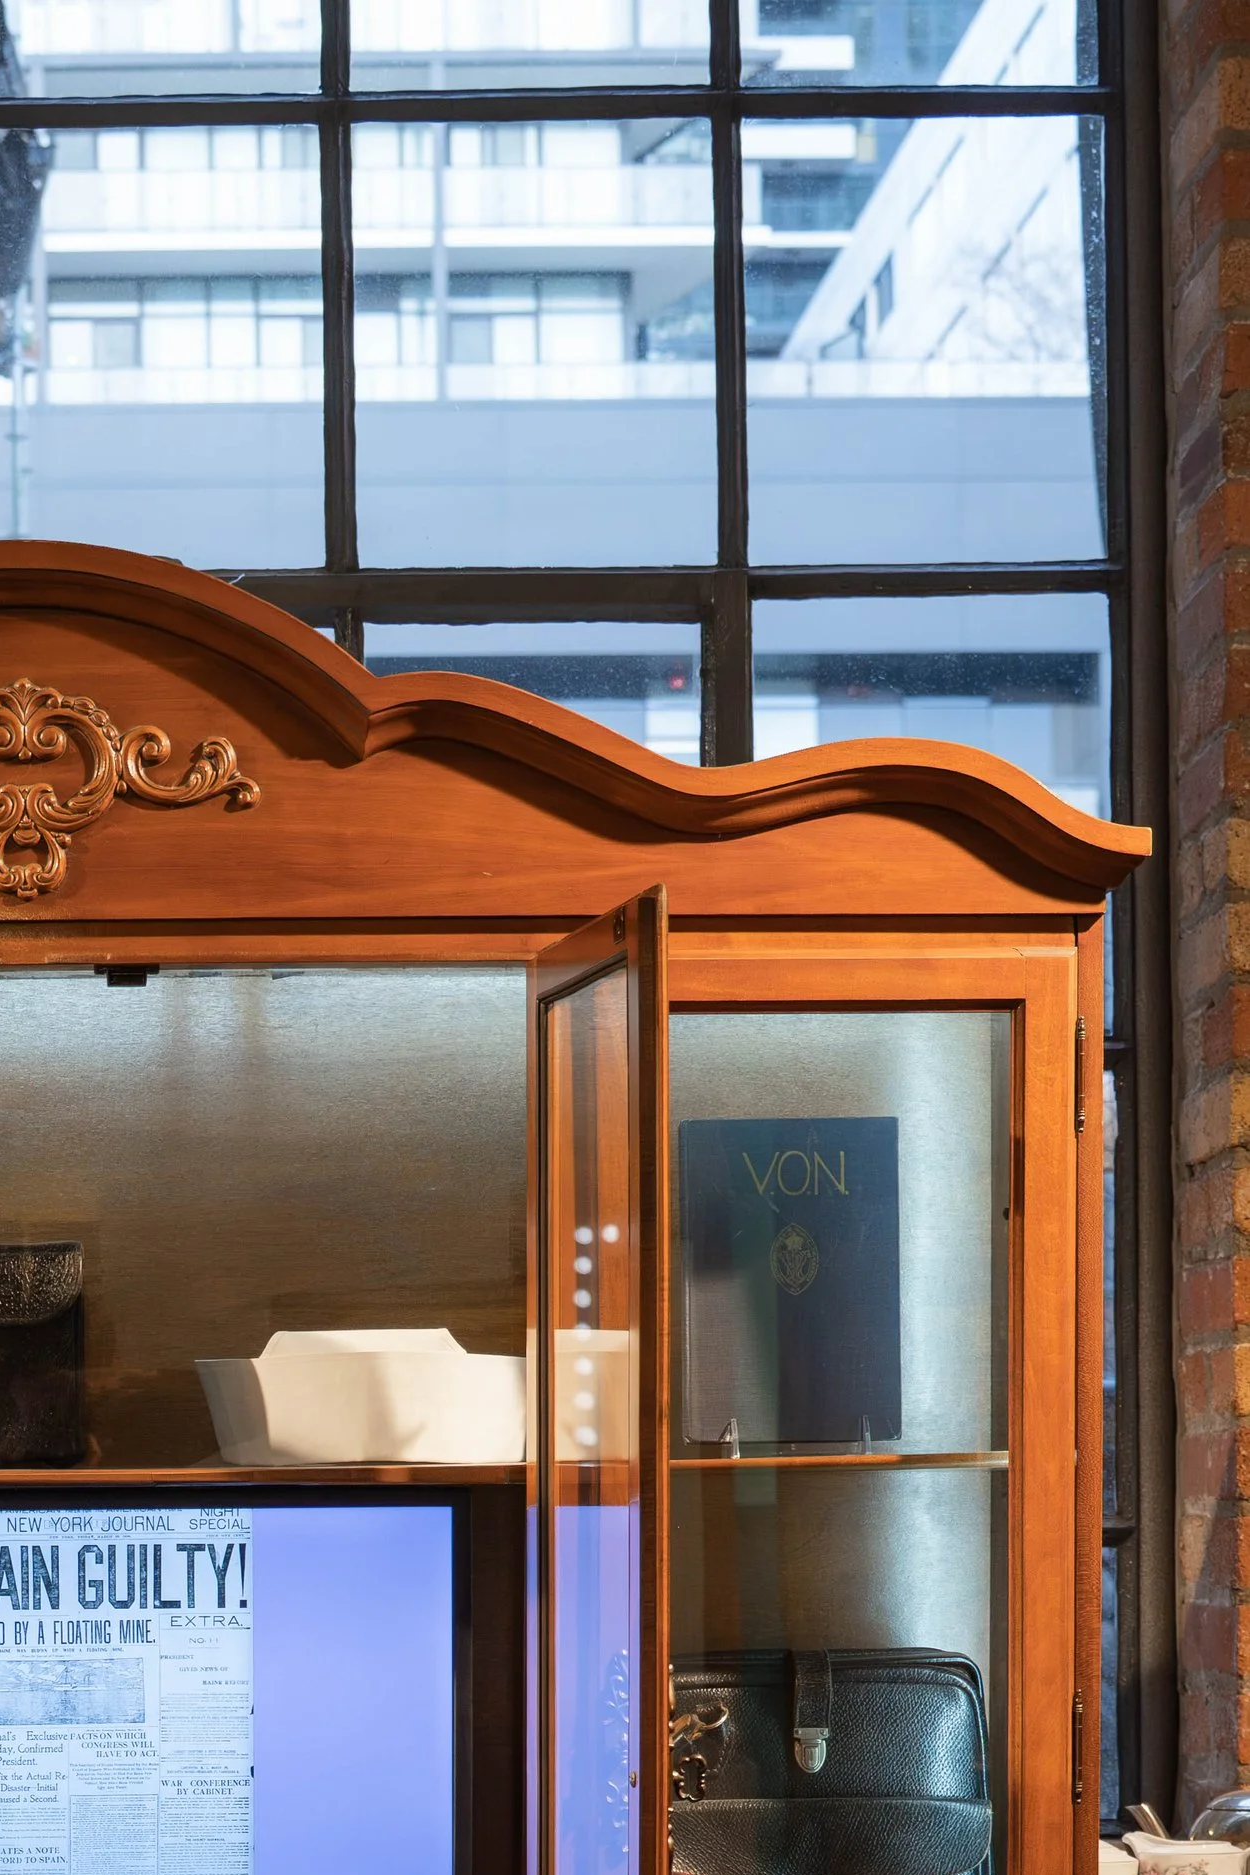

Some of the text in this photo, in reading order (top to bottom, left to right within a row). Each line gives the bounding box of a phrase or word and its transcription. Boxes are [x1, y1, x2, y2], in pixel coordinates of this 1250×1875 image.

[7, 1516, 174, 1532] NEW YORK JOURNAL
[189, 1519, 250, 1530] SPECIAL.
[78, 1543, 248, 1610] GUILTY!
[170, 1616, 243, 1627] EXTRA.
[15, 1621, 29, 1645] BY
[38, 1620, 45, 1644] A
[54, 1620, 111, 1644] FLOATING
[120, 1619, 156, 1644] MINE.
[27, 1731, 68, 1741] Exclusive
